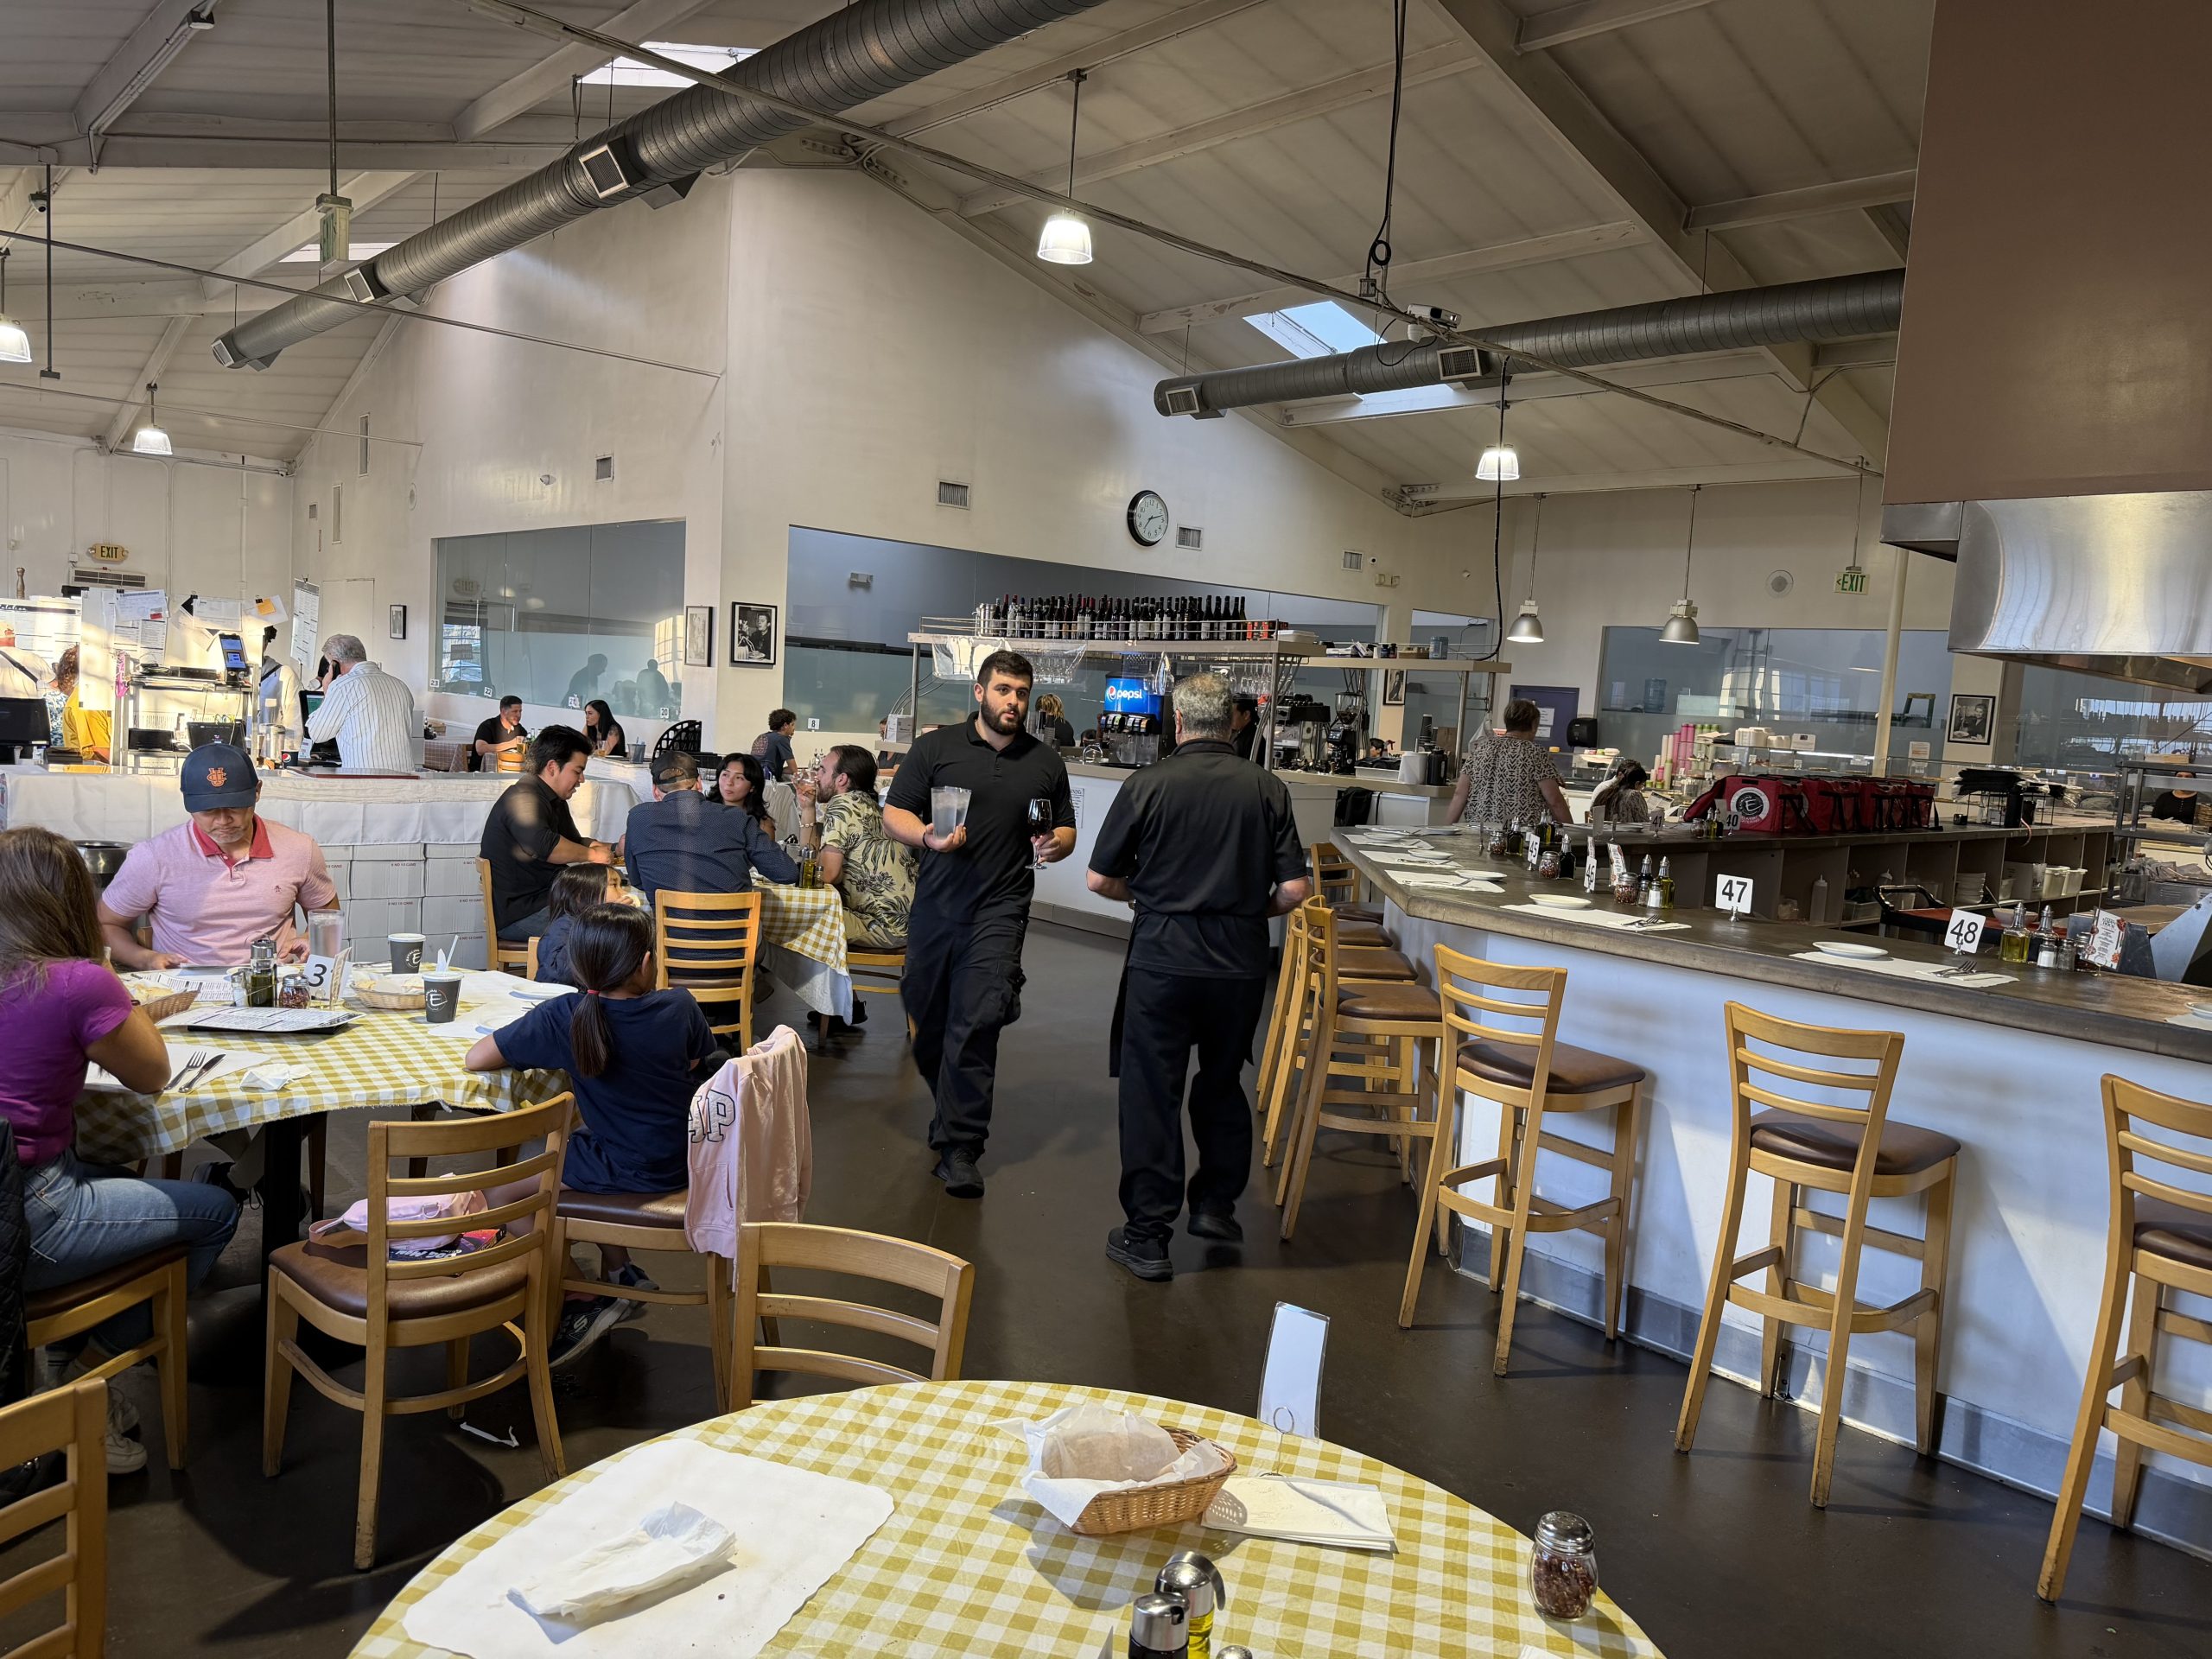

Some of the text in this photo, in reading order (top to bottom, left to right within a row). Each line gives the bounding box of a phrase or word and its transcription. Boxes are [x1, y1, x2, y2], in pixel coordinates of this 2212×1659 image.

[100, 545, 118, 559] EXIT
[1840, 573, 1866, 593] EXIT
[1116, 689, 1143, 701] pepsi
[810, 719, 816, 728] 8
[1652, 815, 1662, 828] 41
[1726, 814, 1739, 827] 40
[1529, 840, 1538, 858] 45
[1586, 863, 1595, 883] 46
[1721, 879, 1748, 904] 47
[1949, 918, 1979, 944] 48
[688, 1089, 736, 1144] AP
